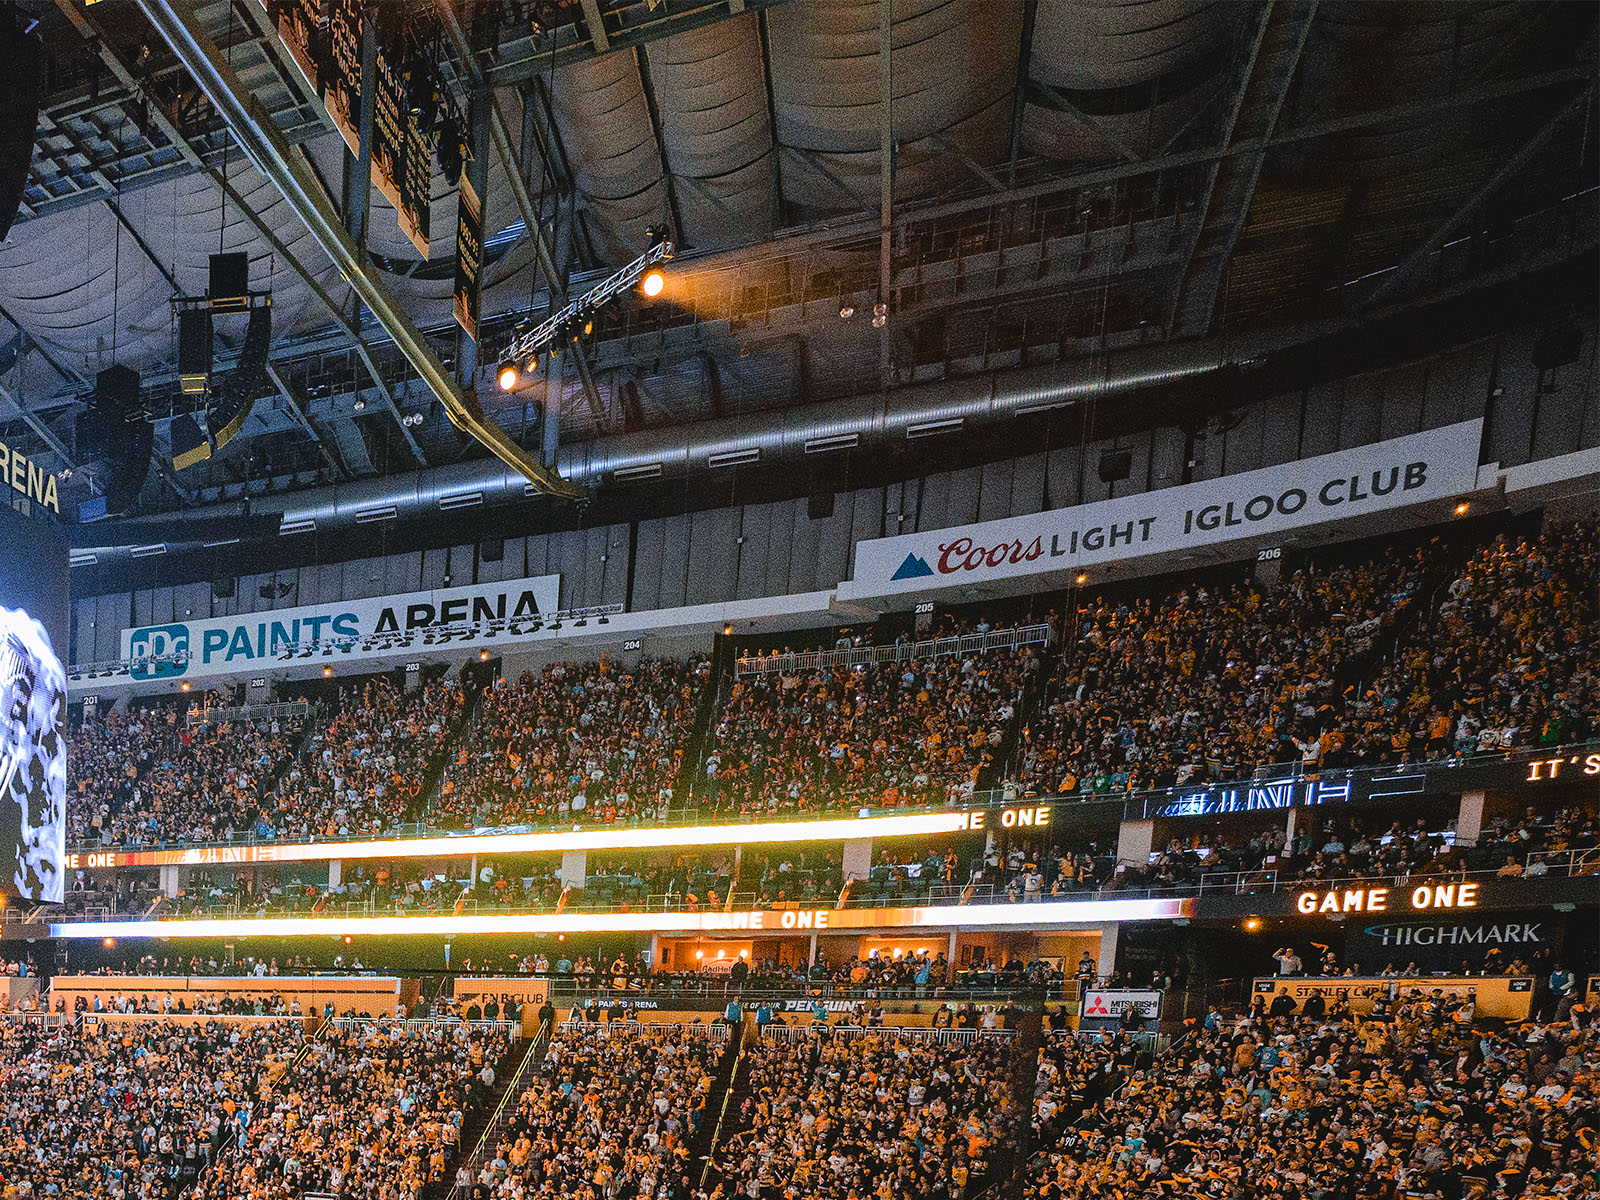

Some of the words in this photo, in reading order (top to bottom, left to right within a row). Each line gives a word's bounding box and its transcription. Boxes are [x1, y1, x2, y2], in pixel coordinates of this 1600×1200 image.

[937, 535, 1045, 575] Coors
[1050, 516, 1157, 557] LIGHT
[1183, 488, 1308, 535] IGLOO
[1318, 461, 1429, 508] CLUB
[1258, 549, 1281, 561] 206
[915, 603, 934, 613] 205
[203, 612, 360, 665] PAINTS
[373, 590, 542, 637] ARENA
[624, 641, 639, 650] 204
[406, 663, 419, 672] 203
[252, 679, 265, 688] 202
[83, 696, 98, 705] 201
[1526, 756, 1600, 782] IT'S
[1002, 806, 1051, 828] ONE
[87, 853, 116, 868] ONE
[1297, 888, 1388, 915] GAME
[1411, 883, 1479, 910] ONE
[780, 910, 829, 930] ONE
[1381, 922, 1542, 946] HIGHMARK
[512, 993, 544, 1004] CLUB
[1110, 1000, 1157, 1008] MITSUBISHI
[86, 1016, 97, 1024] 102
